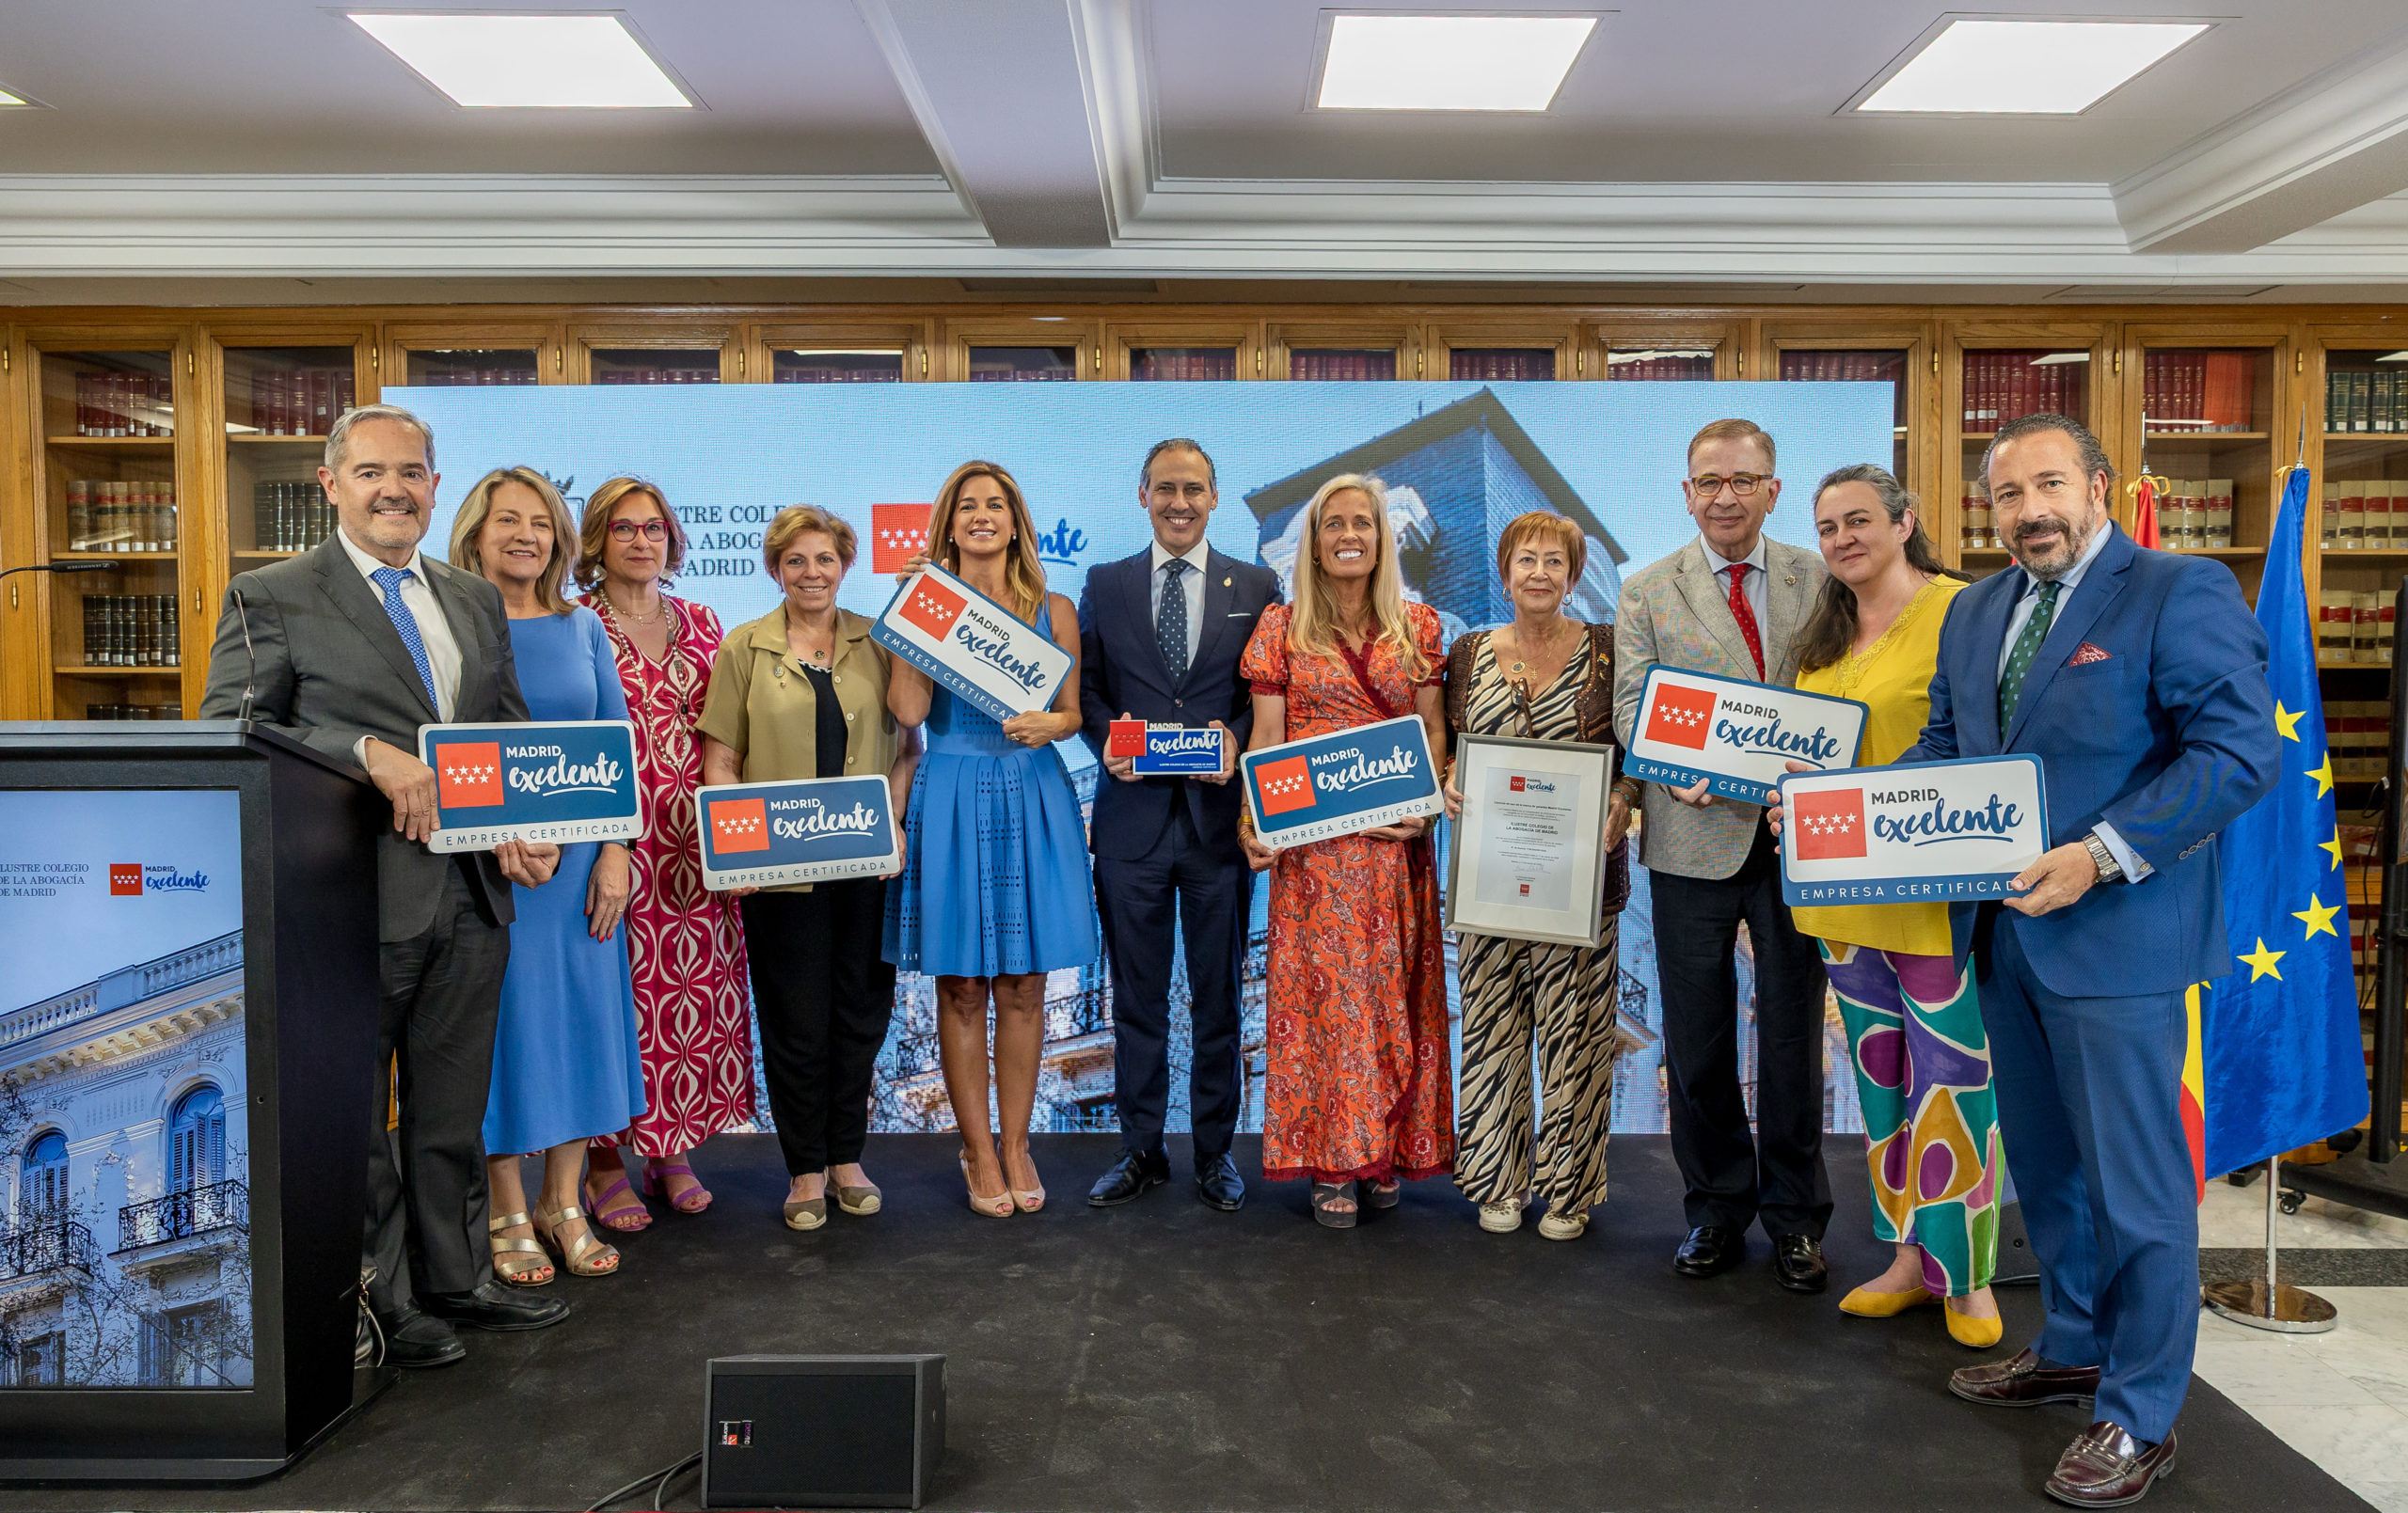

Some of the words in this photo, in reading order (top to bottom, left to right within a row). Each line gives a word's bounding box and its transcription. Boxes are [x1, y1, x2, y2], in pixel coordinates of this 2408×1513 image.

[699, 532, 761, 550] ABOG
[684, 559, 755, 576] ADRID
[967, 608, 1010, 641] MADRID
[882, 632, 938, 672] EMPRESA
[956, 624, 1047, 689] excelente
[1720, 699, 1779, 719] MADRID
[1149, 730, 1221, 754] excelente
[1716, 717, 1842, 761] excelente
[506, 746, 562, 759] MADRID
[1311, 748, 1360, 766] MADRID
[509, 752, 624, 793] excelente
[1317, 745, 1418, 792] excelente
[1639, 764, 1698, 784] EMPRES
[770, 798, 821, 812] MADRID
[1871, 788, 1940, 805] MADRID
[773, 801, 879, 839] excelente
[1273, 825, 1334, 845] EMPRESA
[1341, 802, 1432, 829] CERTIFICADA
[1874, 794, 2023, 843] excelente
[446, 831, 519, 846] EMPRESA
[530, 824, 629, 840] CERTIFICADA
[0, 863, 40, 873] LUSTRE
[43, 863, 89, 873] COLEGIO
[719, 871, 784, 885] EMPRESA
[793, 861, 886, 877] CERTIFICADA
[13, 875, 27, 885] LA
[30, 874, 85, 885] ABOGACÍA
[146, 870, 211, 890] excelente
[13, 888, 56, 897] MADRID
[1801, 886, 1885, 900] EMPRESA
[1896, 880, 2030, 896] CERTIFICAD
